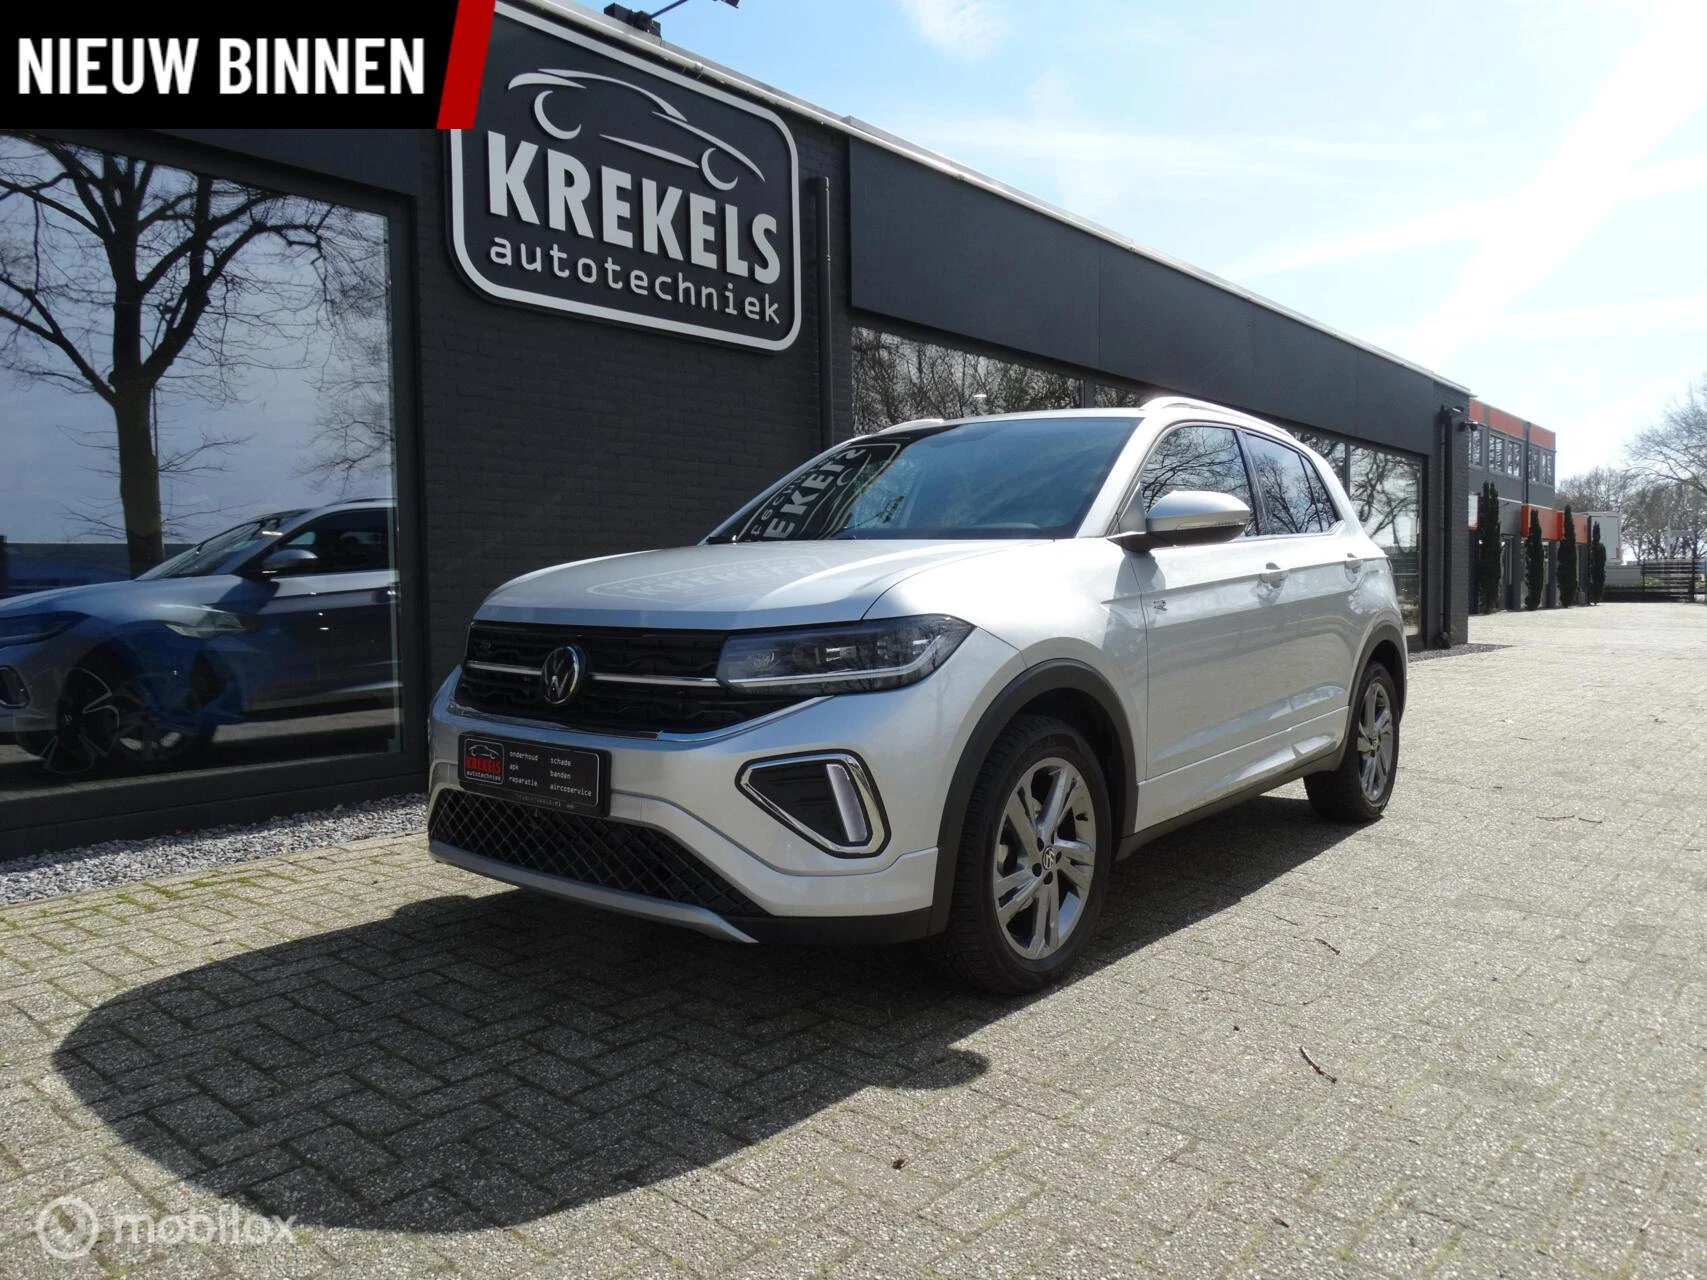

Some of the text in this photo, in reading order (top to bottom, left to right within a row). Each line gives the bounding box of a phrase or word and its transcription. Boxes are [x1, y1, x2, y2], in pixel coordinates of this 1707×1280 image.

[487, 130, 781, 285] KREKELS
[489, 236, 780, 325] autotechniek
[509, 751, 539, 761] onderhoud
[509, 763, 519, 771] apk
[550, 757, 572, 767] schade
[550, 770, 572, 780] banden
[508, 776, 538, 787] reparatie
[550, 784, 592, 797] aircoservice
